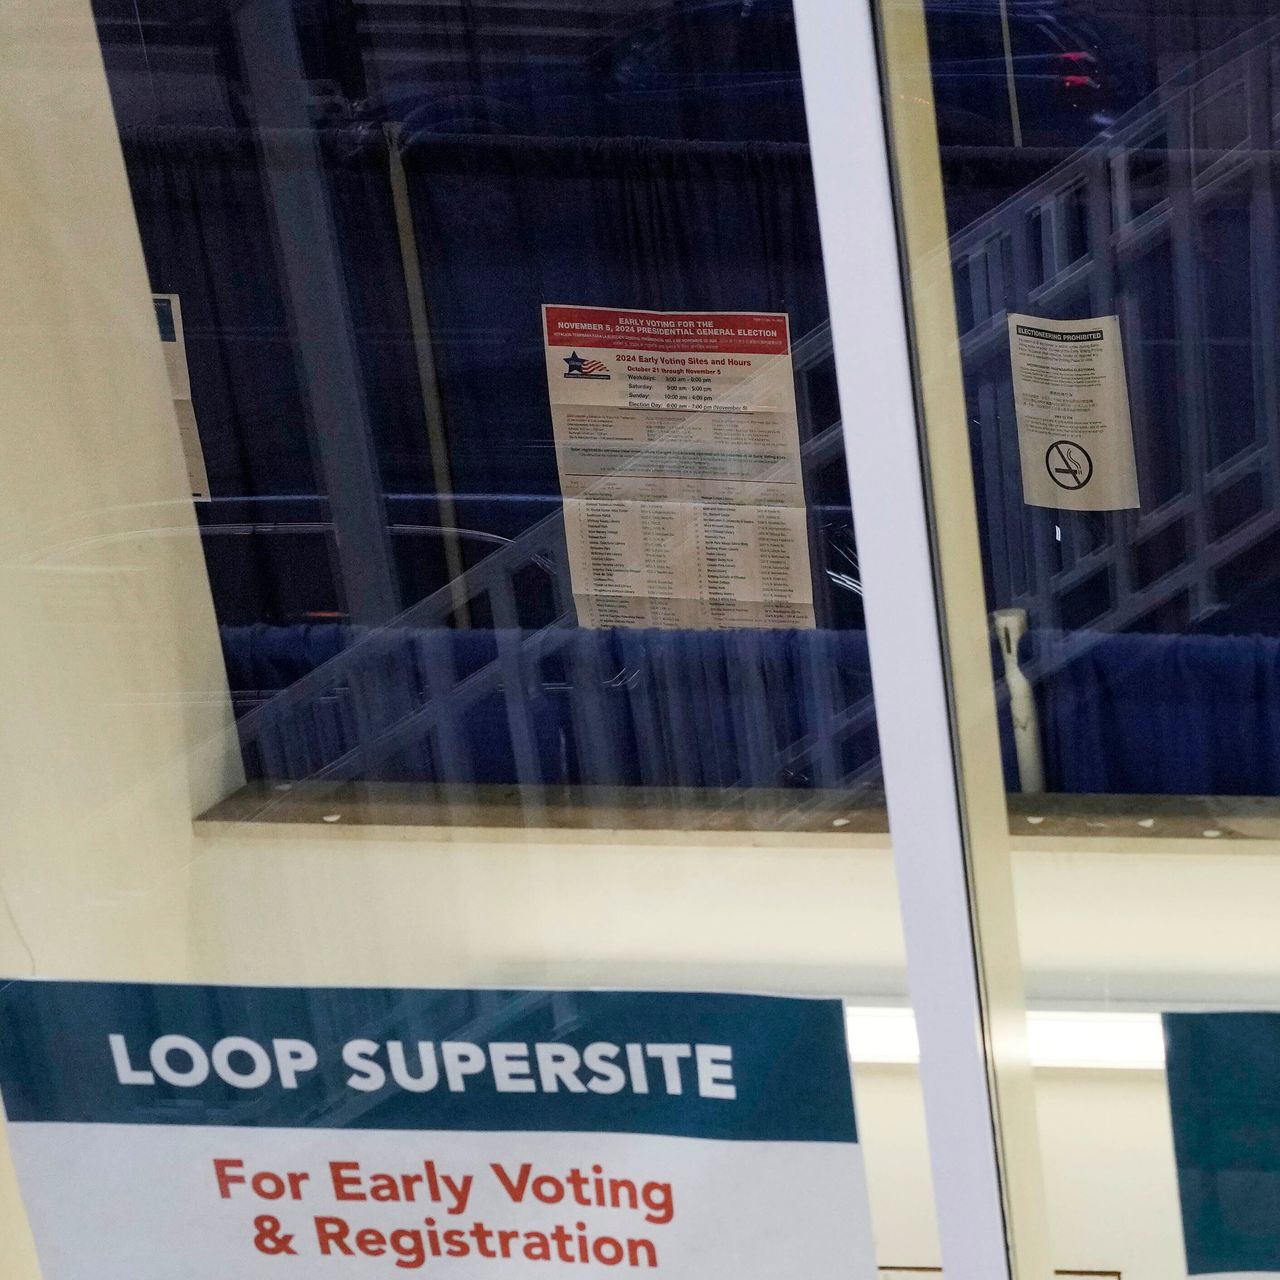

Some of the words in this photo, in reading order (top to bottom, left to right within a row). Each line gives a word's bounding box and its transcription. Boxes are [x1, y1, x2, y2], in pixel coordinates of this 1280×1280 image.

[557, 321, 604, 332] NOVEMBER
[615, 324, 635, 333] 2024
[636, 325, 694, 337] PRESIDENTIAL
[696, 328, 735, 337] GENERAL
[737, 329, 777, 338] ELECTION
[618, 317, 644, 326] EARLY
[646, 319, 675, 327] VOTING
[677, 320, 694, 328] FOR
[696, 320, 714, 328] THE
[1017, 327, 1062, 341] ELECTIONEERING
[1062, 331, 1102, 341] PROHIBITED
[615, 354, 637, 363] 2024
[638, 355, 659, 366] Early
[659, 356, 686, 367] Voting
[687, 357, 707, 366] Sites
[709, 357, 726, 366] and
[727, 358, 752, 367] Hours
[109, 1034, 317, 1088] LOOP
[342, 1039, 736, 1099] SUPERSITE
[213, 1159, 309, 1200] For
[329, 1160, 473, 1215] Early
[490, 1163, 674, 1225] Voting
[254, 1215, 297, 1255] &
[314, 1216, 659, 1270] Registration
